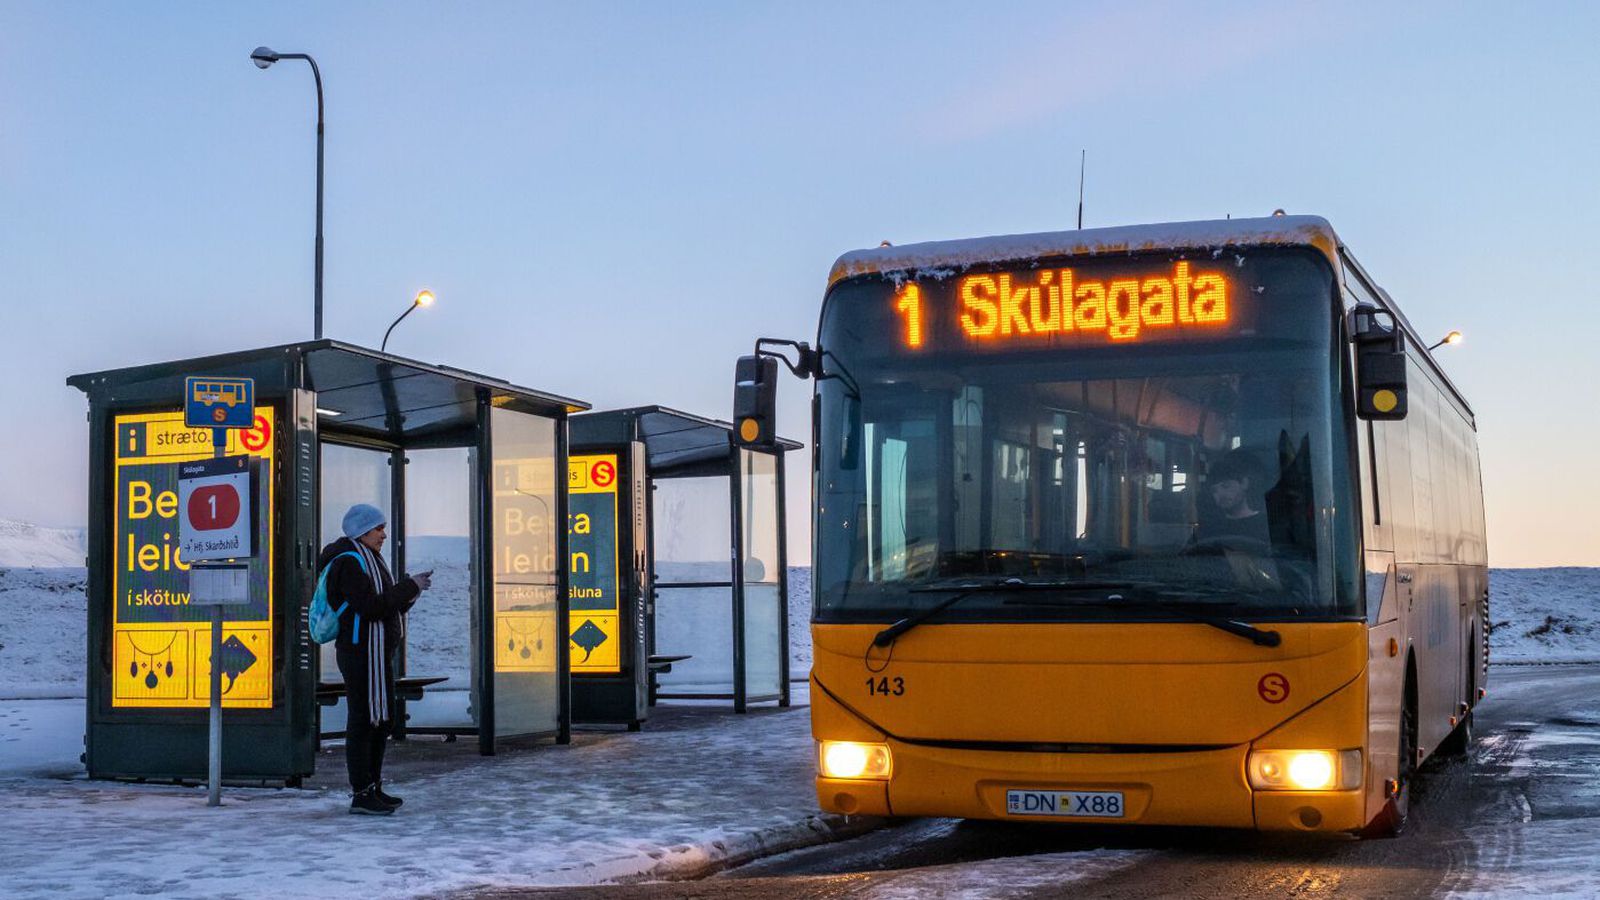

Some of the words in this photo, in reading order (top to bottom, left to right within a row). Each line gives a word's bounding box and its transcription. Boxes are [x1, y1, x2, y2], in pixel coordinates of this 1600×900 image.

[898, 283, 920, 346] 1
[961, 261, 1227, 339] Skúlagata
[595, 463, 612, 486] S
[208, 494, 217, 520] 1
[866, 677, 905, 697] 143
[1262, 674, 1286, 702] S
[1024, 793, 1055, 812] DN
[1075, 795, 1120, 814] X88
